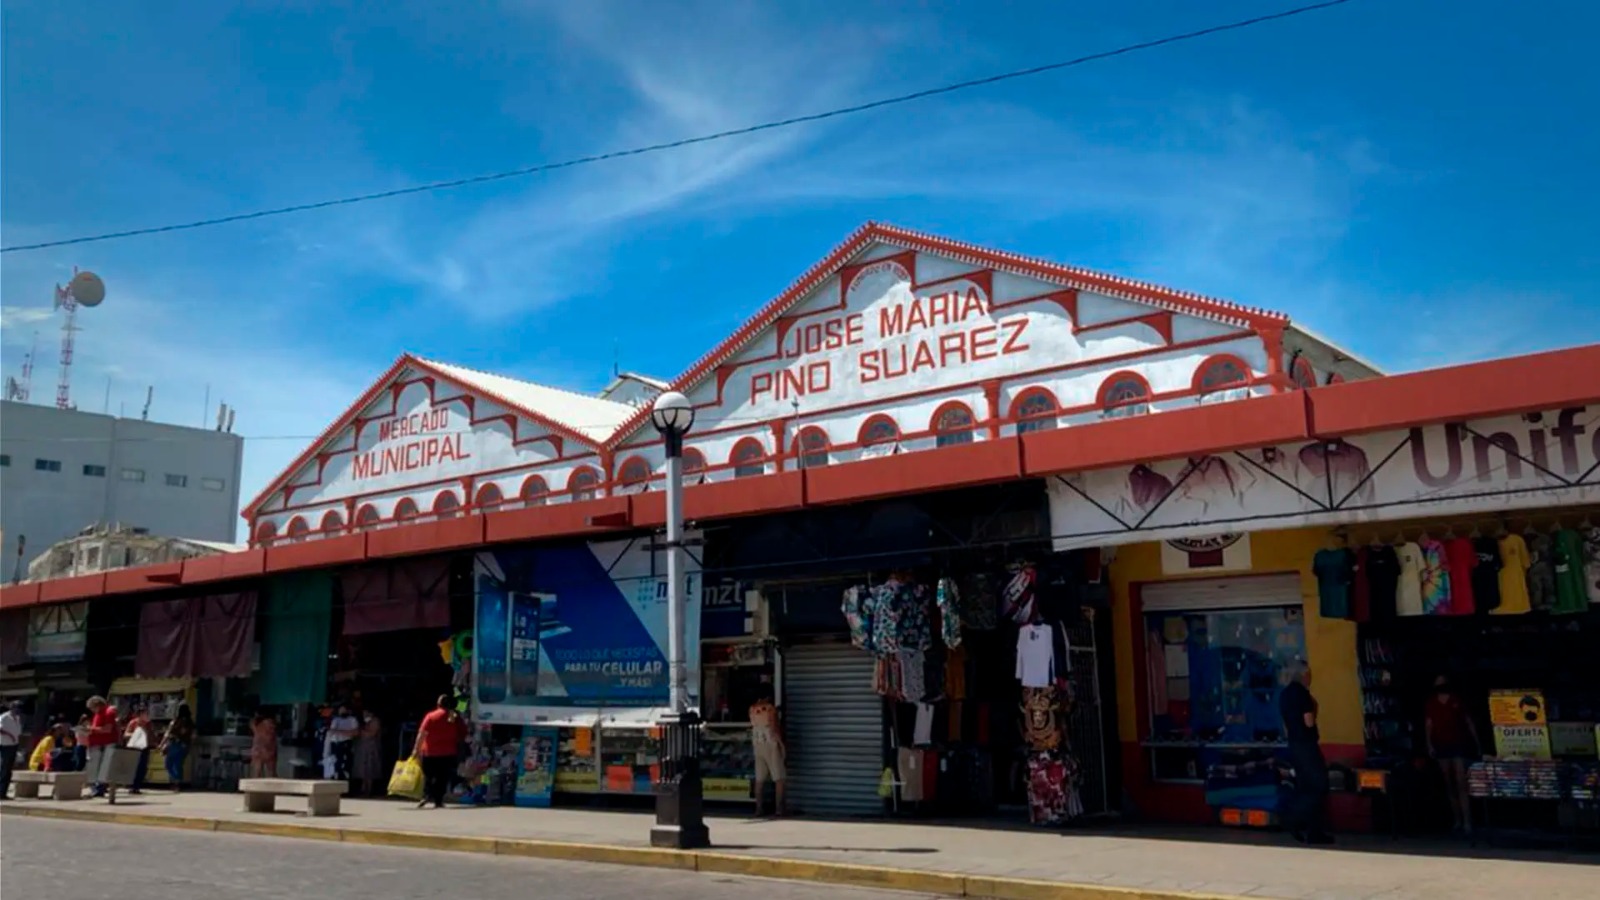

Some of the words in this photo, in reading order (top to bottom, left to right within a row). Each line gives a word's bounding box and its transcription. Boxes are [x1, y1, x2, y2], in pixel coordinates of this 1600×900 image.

[785, 313, 864, 358] JOSE
[879, 287, 988, 338] MARIA
[751, 361, 831, 405] PINO
[860, 318, 1030, 383] SUAREZ
[379, 407, 448, 442] MERCADO
[1409, 406, 1600, 488] Unif
[352, 432, 471, 480] MUNICIPAL
[564, 662, 588, 673] PARA
[589, 661, 602, 672] TU
[602, 660, 663, 677] CELULAR
[1503, 728, 1545, 737] OFERTA
